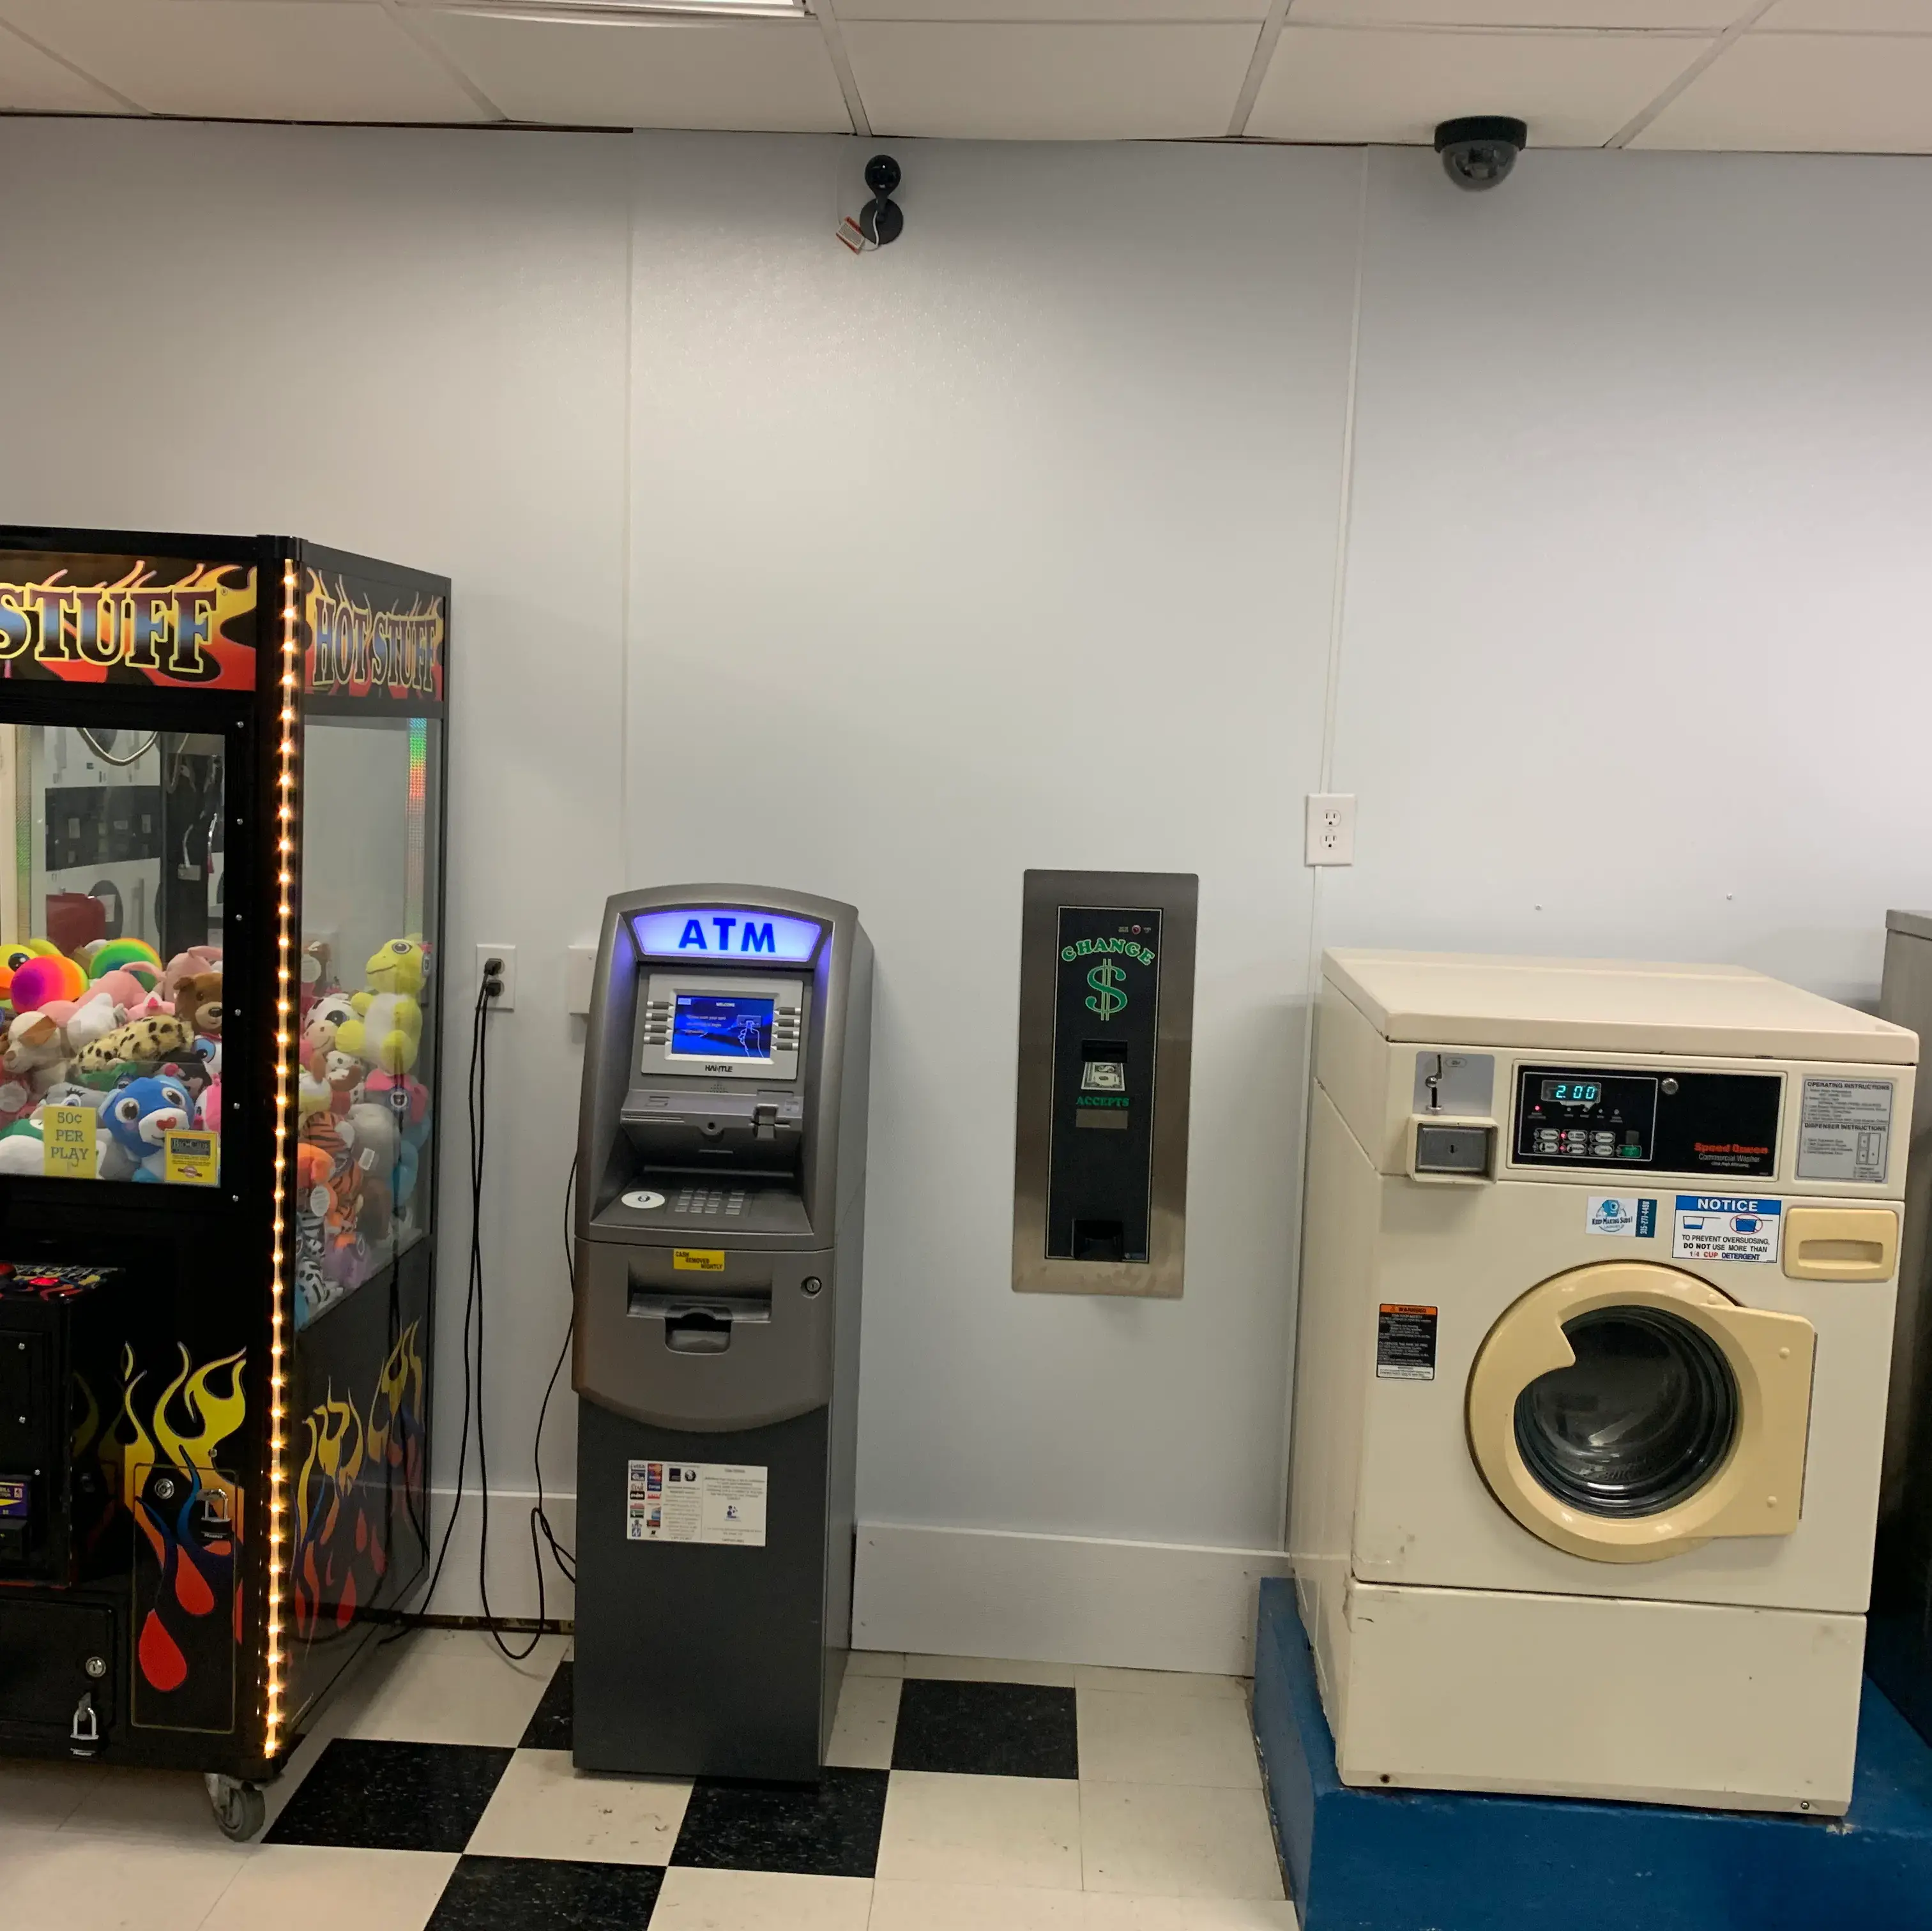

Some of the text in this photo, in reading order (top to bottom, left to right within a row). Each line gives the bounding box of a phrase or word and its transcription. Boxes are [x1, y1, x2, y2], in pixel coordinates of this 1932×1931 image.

[0, 582, 218, 673] STUFF
[314, 595, 439, 692] HOT STUFF
[678, 918, 776, 953] ATM
[1061, 937, 1155, 966] CHANGE
[1076, 1096, 1130, 1107] ACCEPTS
[56, 1129, 84, 1142] PER
[50, 1146, 89, 1162] PLAY
[1694, 1142, 1768, 1154] Speed Queen
[1698, 1199, 1758, 1211] NOTICE
